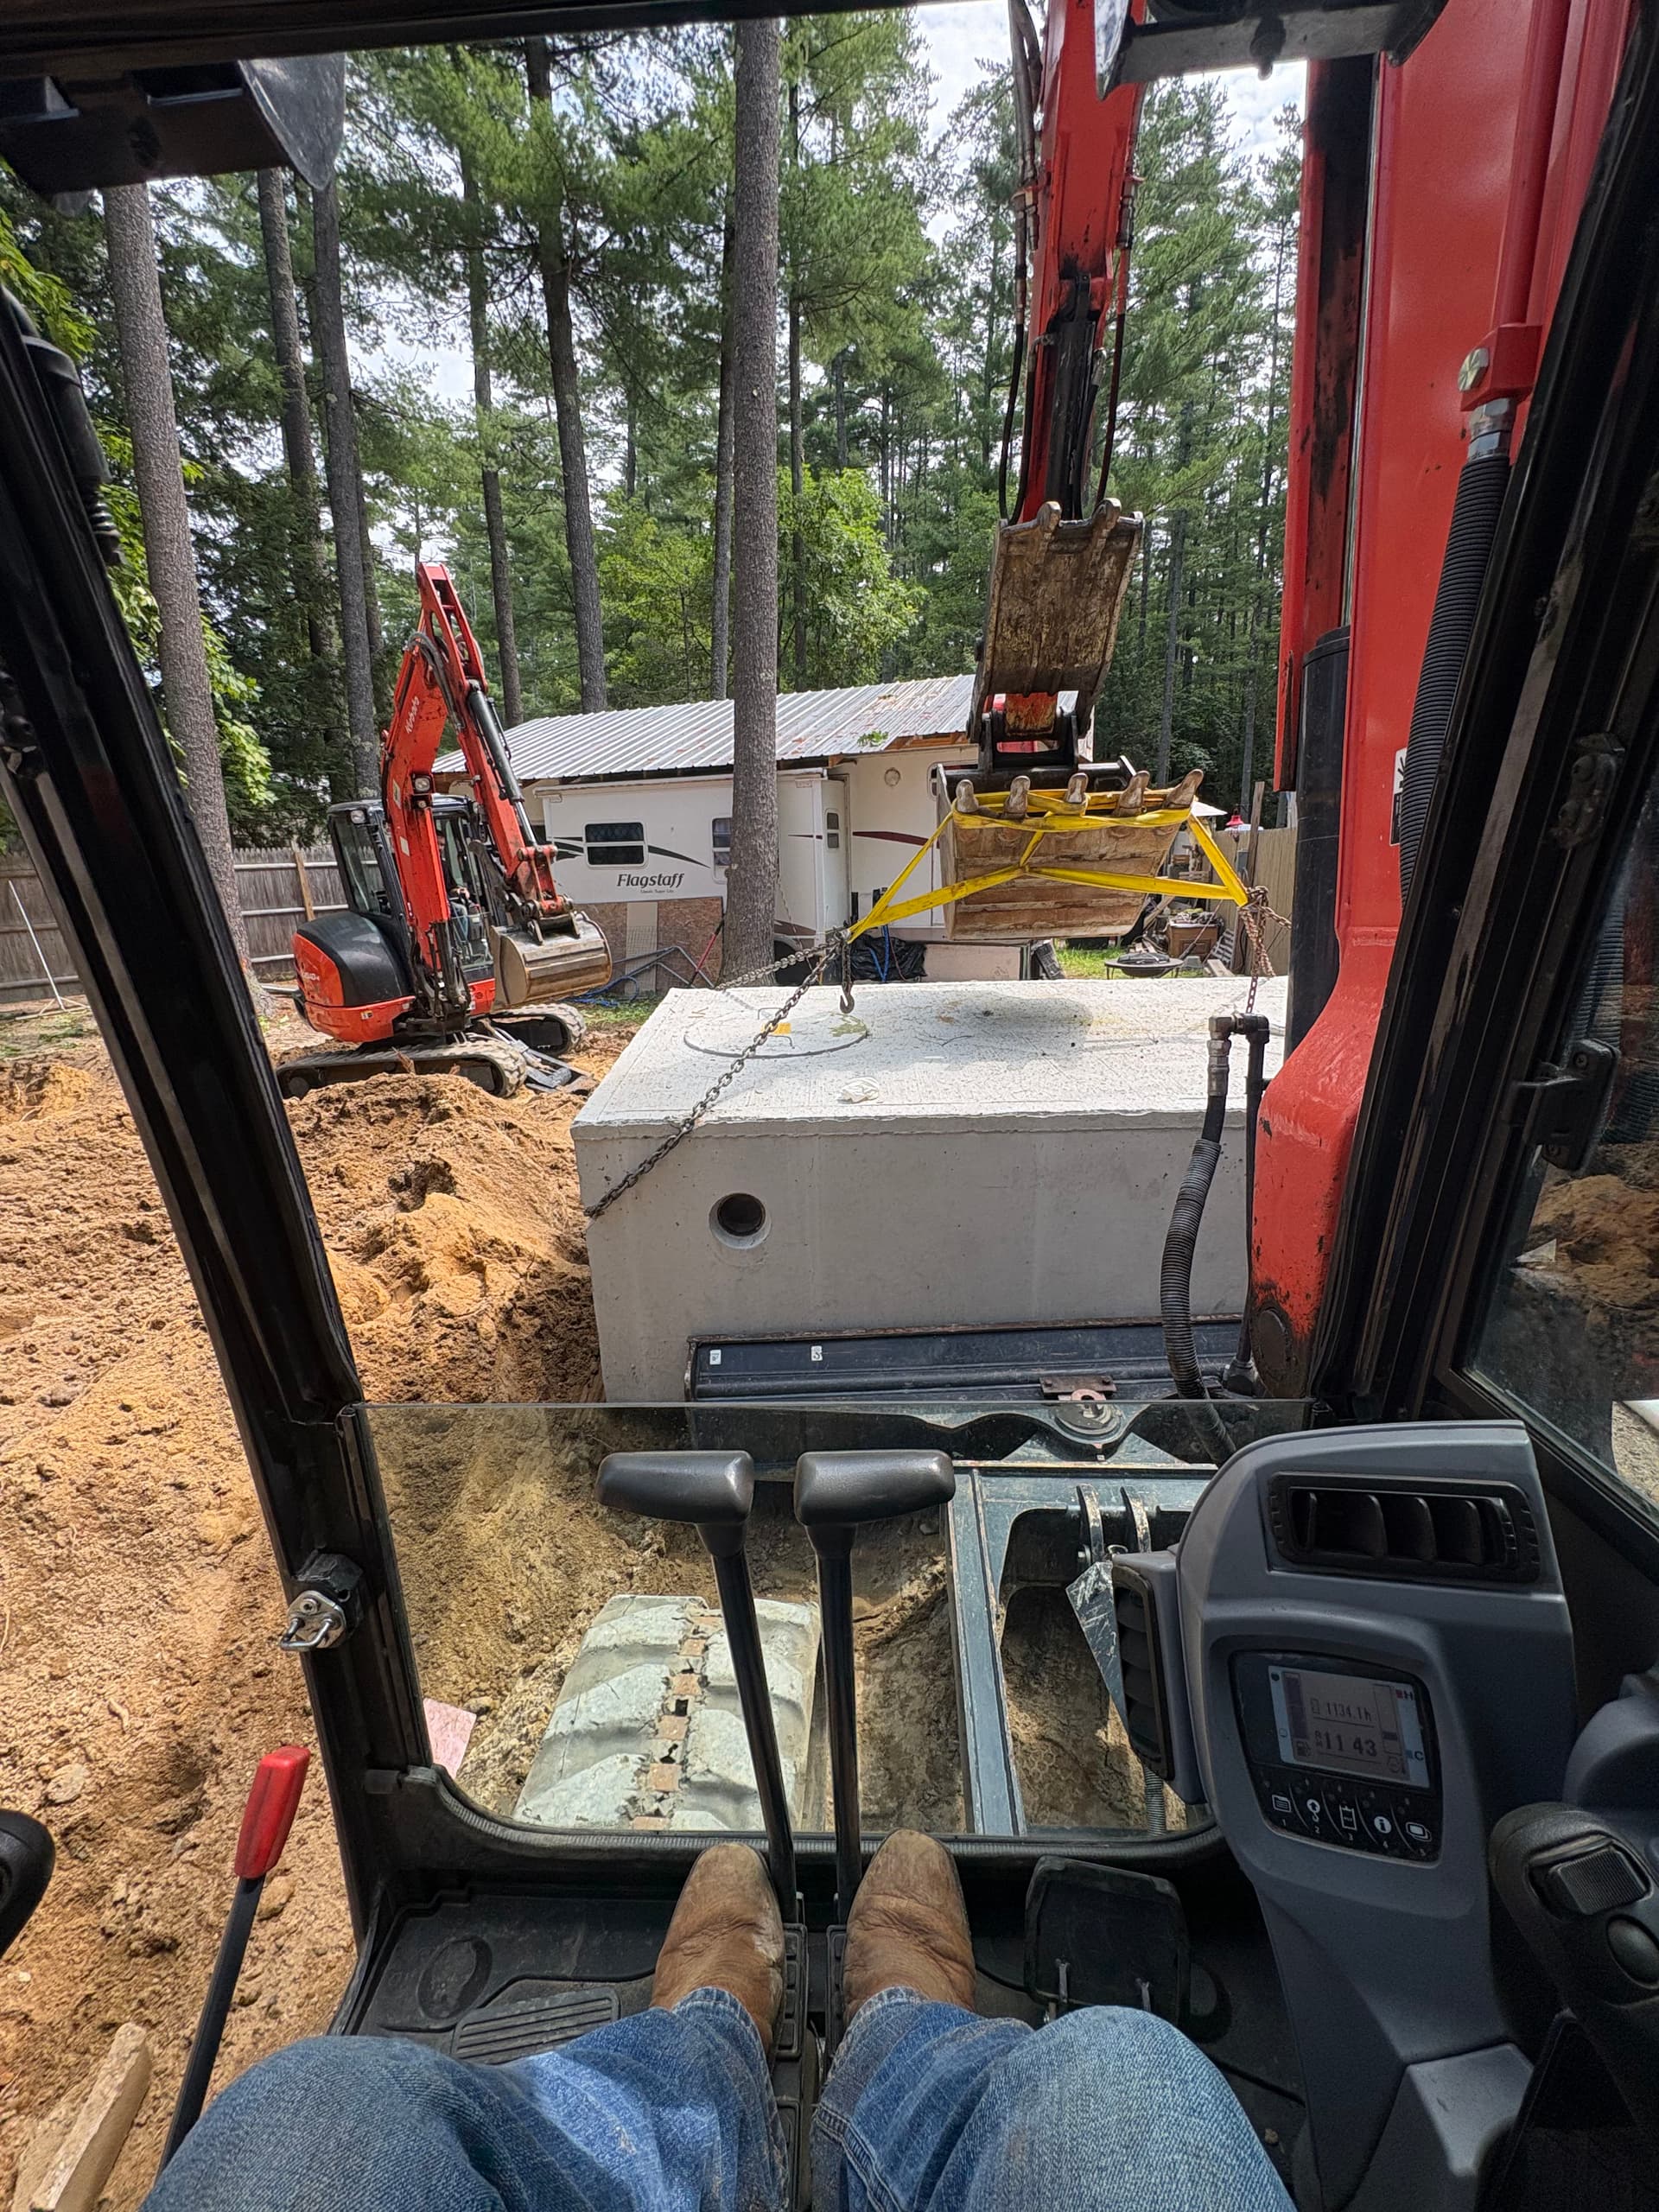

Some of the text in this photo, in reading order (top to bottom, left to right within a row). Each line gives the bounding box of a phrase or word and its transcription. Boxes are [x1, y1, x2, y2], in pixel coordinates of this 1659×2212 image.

[616, 873, 685, 888] Flagstaff
[1403, 1690, 1414, 1700] H
[1414, 1751, 1425, 1761] C
[1314, 1825, 1320, 1834] 2
[1348, 1833, 1354, 1841] 3
